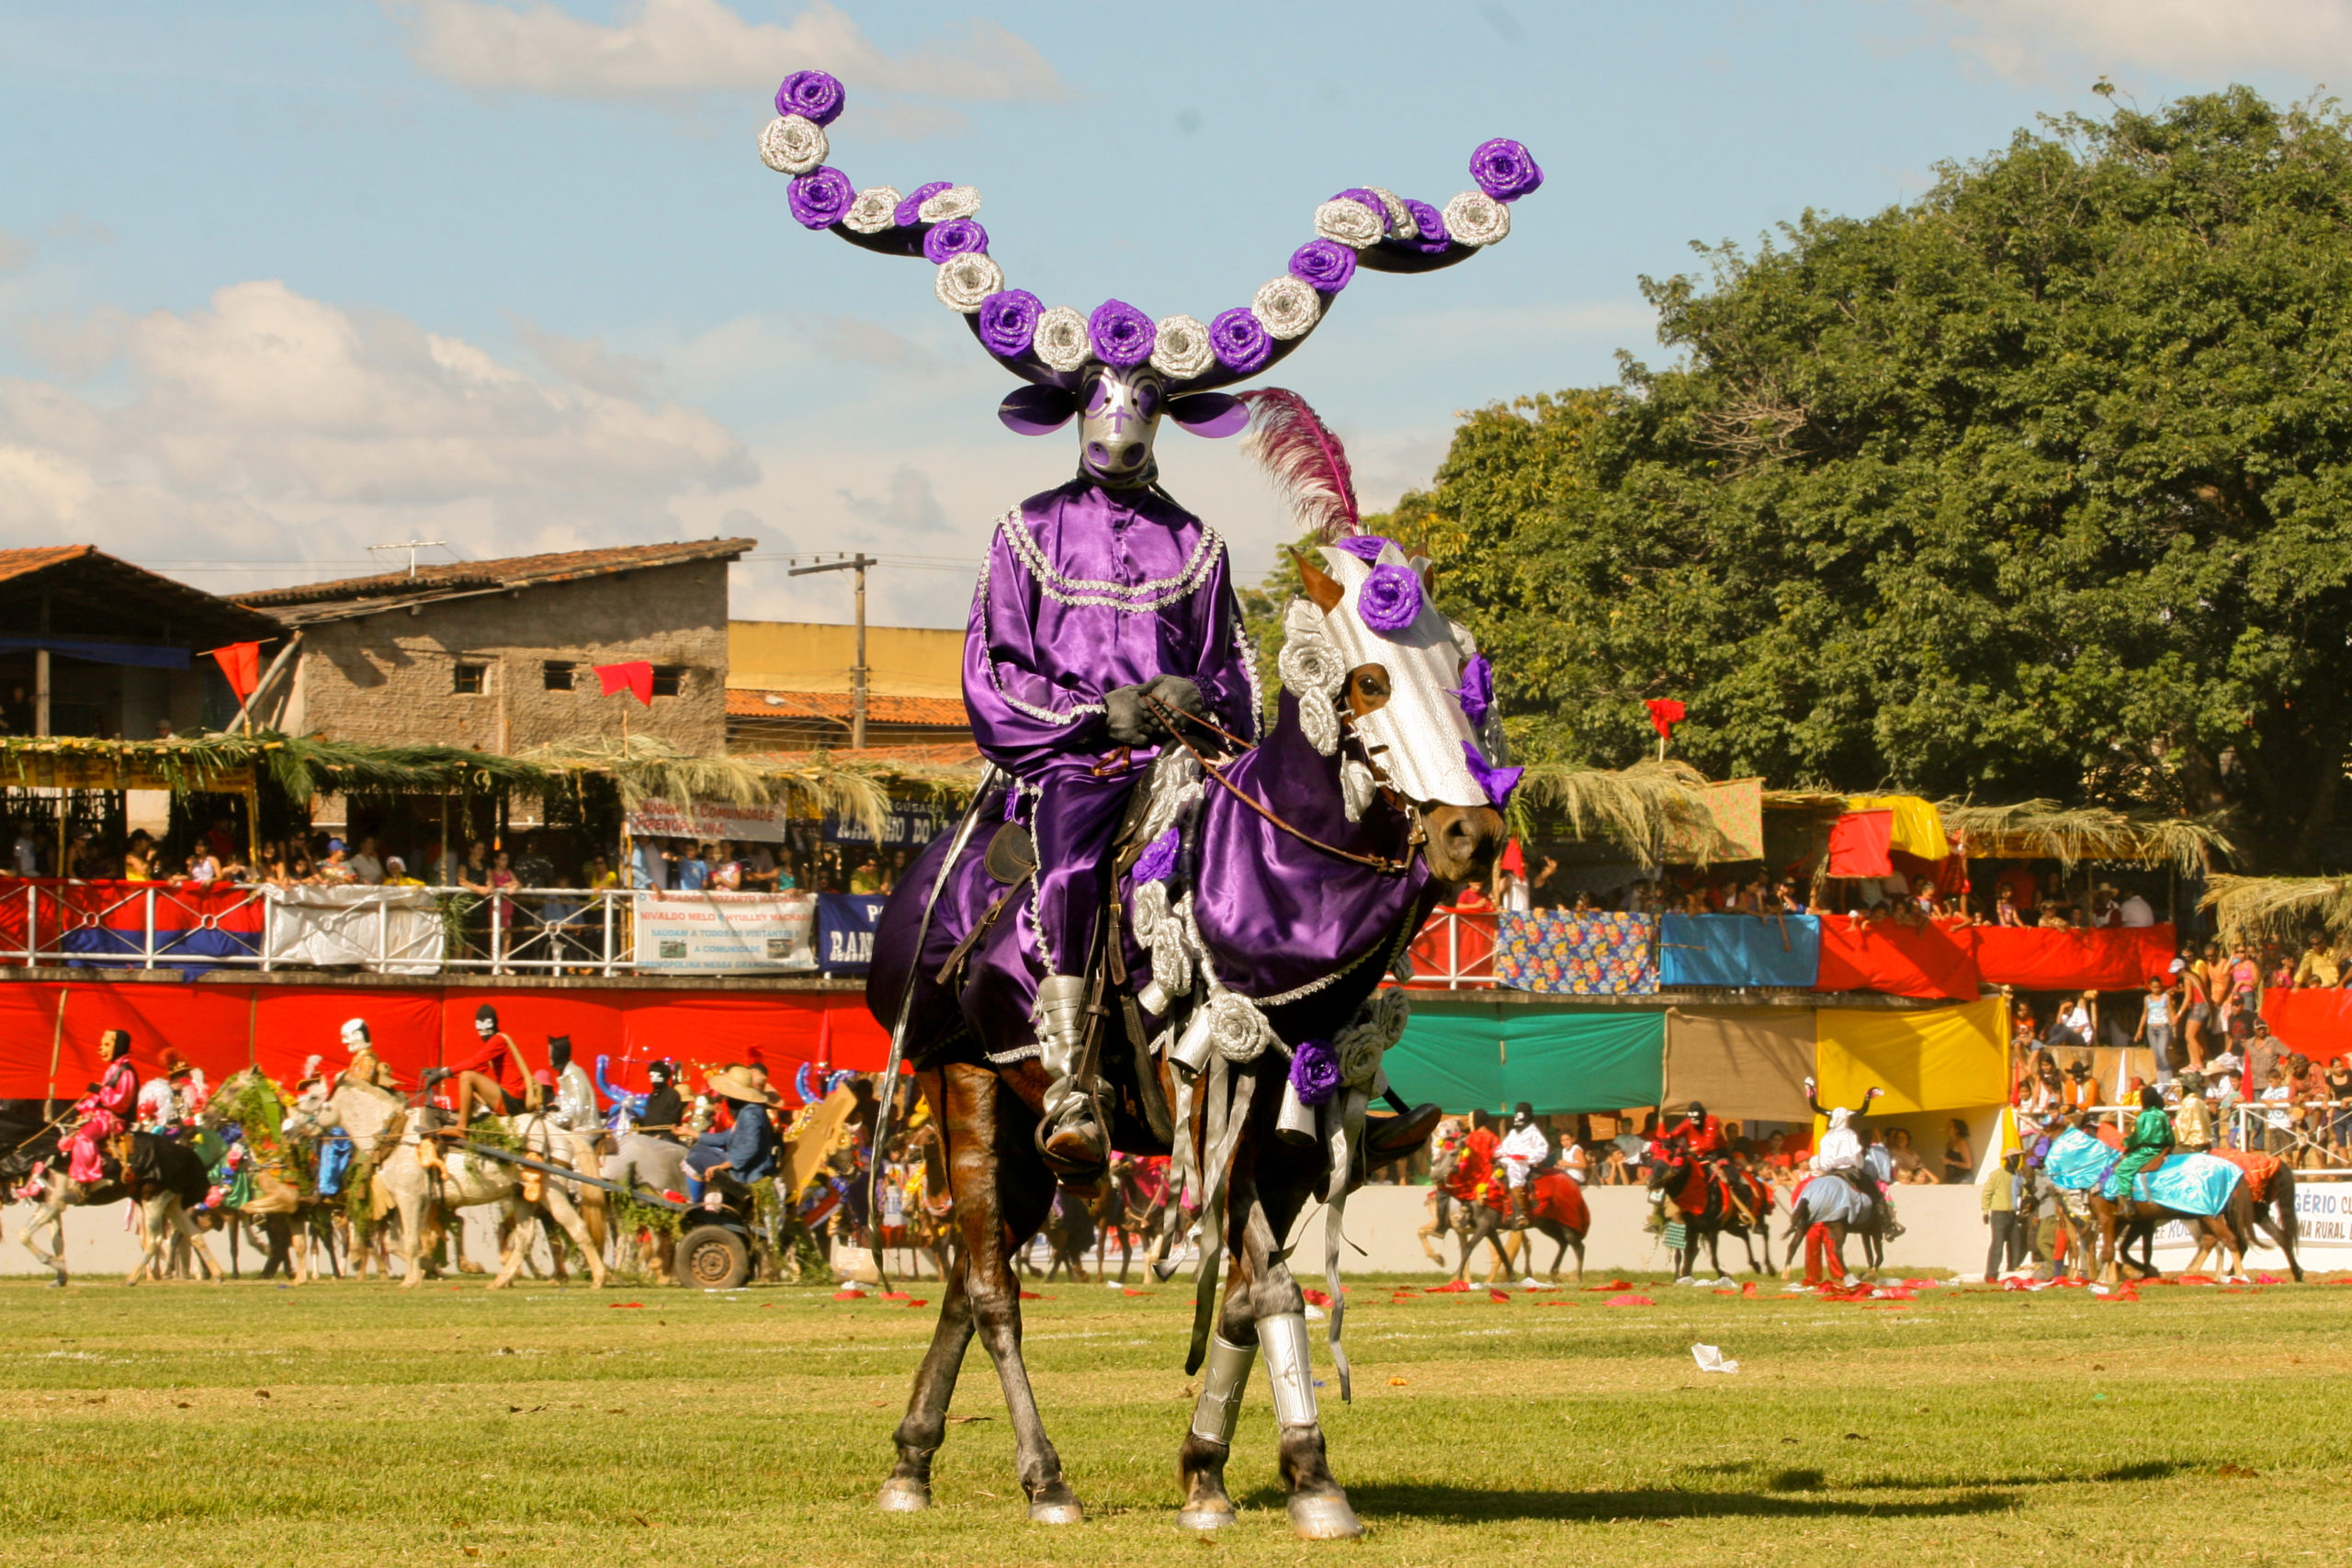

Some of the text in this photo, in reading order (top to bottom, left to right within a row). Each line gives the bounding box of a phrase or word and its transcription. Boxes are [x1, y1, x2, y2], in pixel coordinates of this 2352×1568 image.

[912, 818, 930, 844] DO
[649, 894, 705, 903] VREADOR
[640, 912, 685, 920] NIVALDO
[2315, 1220, 2345, 1239] RURAL
